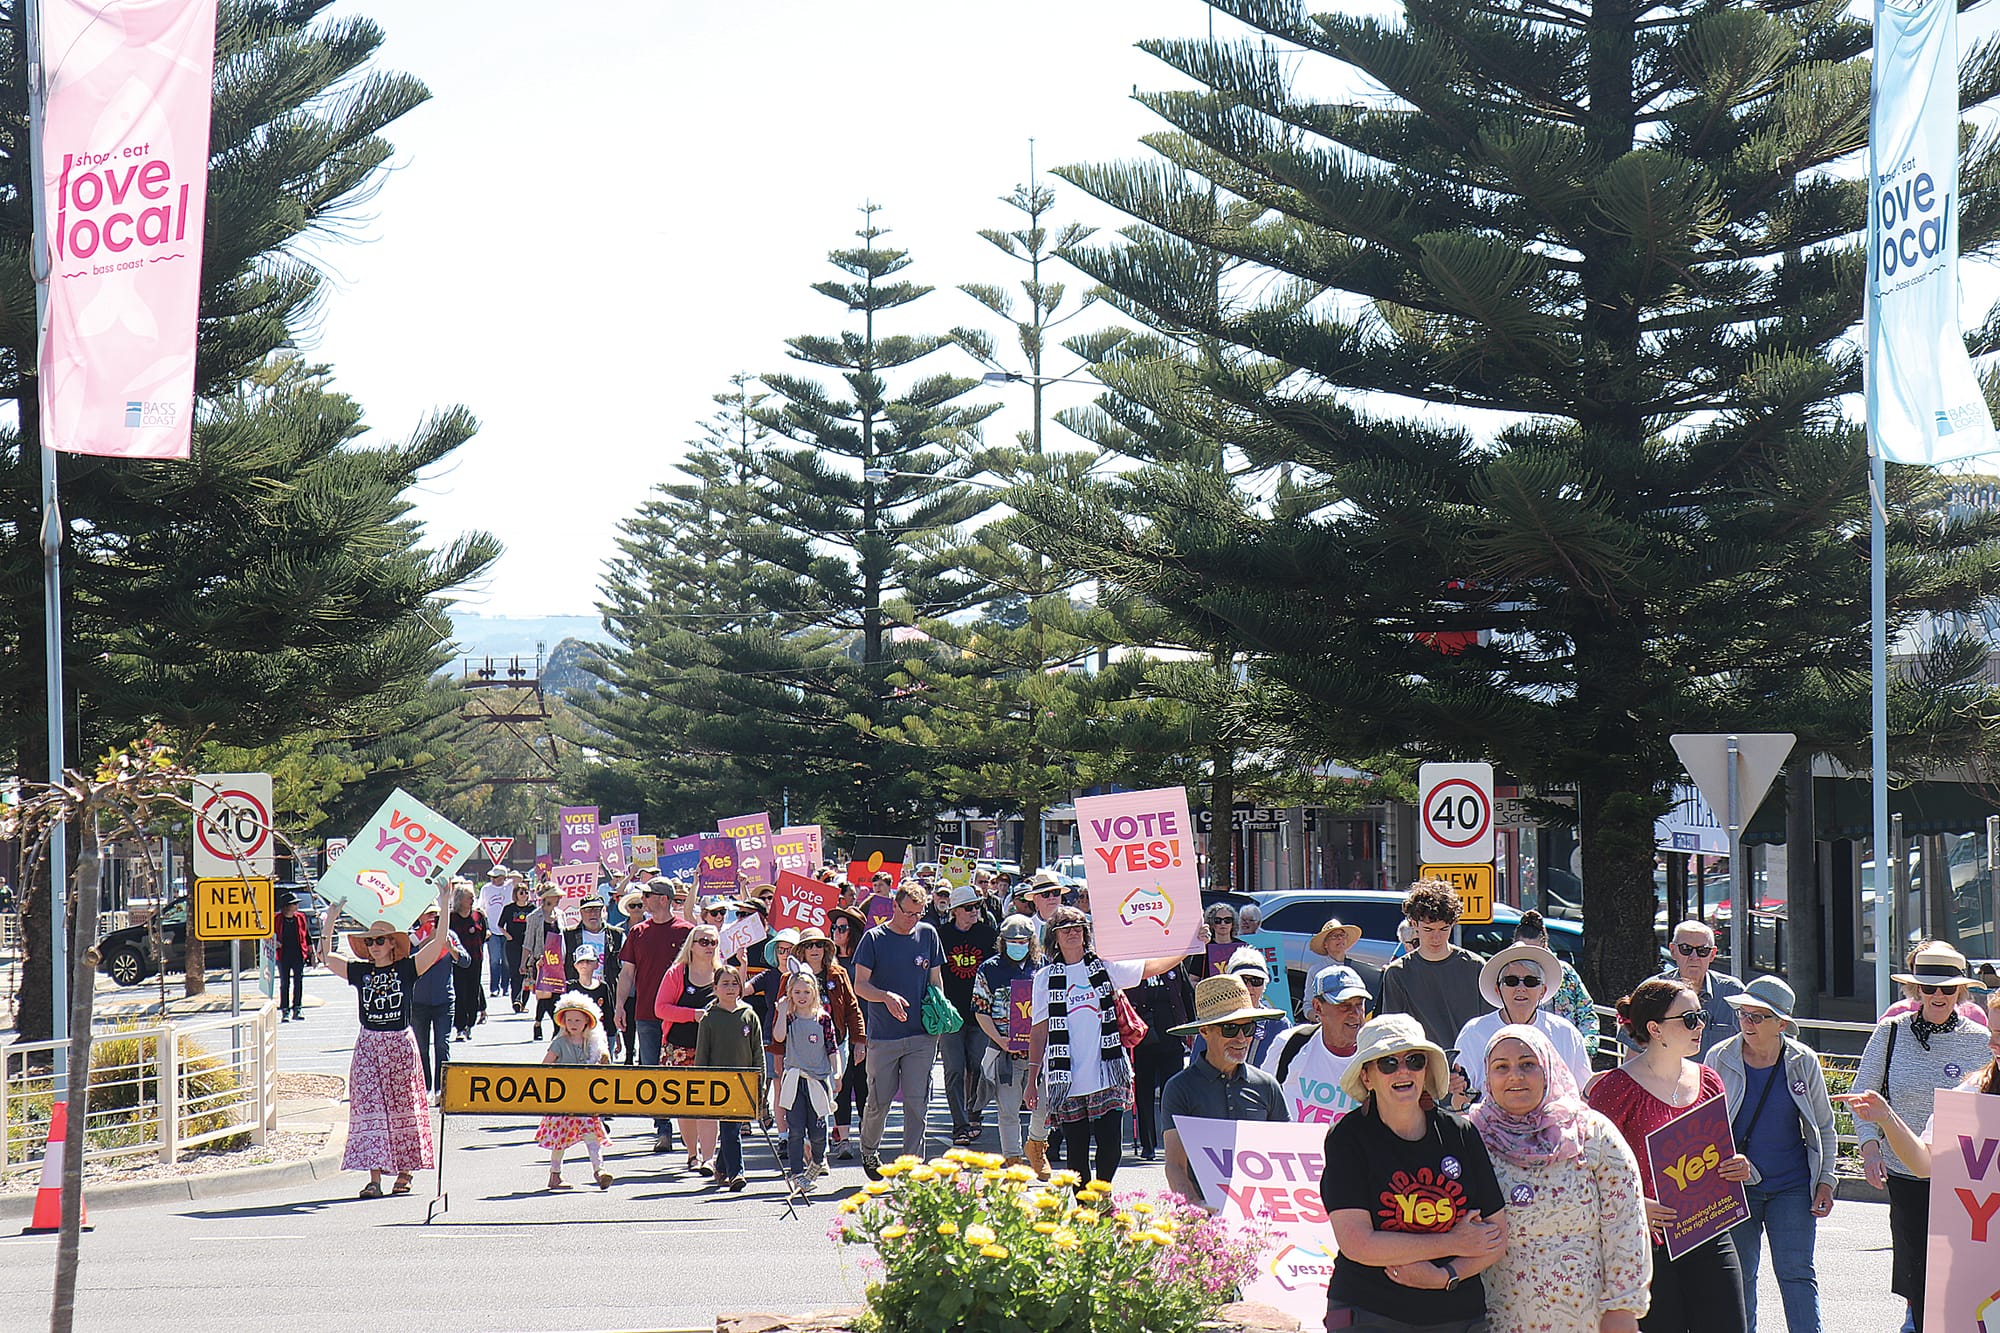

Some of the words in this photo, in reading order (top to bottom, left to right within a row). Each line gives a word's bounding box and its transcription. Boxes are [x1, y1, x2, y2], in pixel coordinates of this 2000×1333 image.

[76, 152, 110, 166] shop
[123, 143, 150, 158] eat
[1902, 156, 1916, 174] eat
[58, 154, 171, 211] love
[1876, 172, 1936, 230] love
[56, 184, 189, 262] local
[1874, 193, 1950, 282] local
[92, 265, 114, 275] bass
[116, 259, 144, 272] coast
[143, 402, 176, 415] BASS
[1948, 402, 1981, 421] BASS
[142, 416, 176, 425] COAST
[565, 814, 595, 824] VOTE
[1432, 795, 1480, 830] 40
[208, 808, 258, 843] 40
[565, 824, 595, 835] YES!
[600, 829, 618, 840] VOTE
[725, 823, 765, 838] VOTE
[1090, 811, 1178, 842] VOTE
[389, 809, 459, 865] VOTE
[601, 838, 619, 850] YES!
[375, 826, 444, 885] YES!
[636, 846, 651, 854] Yes
[672, 843, 694, 853] Vote
[1094, 840, 1182, 874] YES!
[704, 854, 732, 870] Yes
[368, 876, 395, 896] yes23
[556, 873, 593, 886] VOTE
[212, 887, 256, 905] NEW
[792, 883, 824, 905] Vote
[781, 895, 826, 926] YES
[1131, 901, 1163, 914] yes23
[206, 910, 263, 929] LIMIT
[728, 925, 752, 953] YES
[545, 950, 559, 965] Yes
[952, 954, 977, 967] Yes
[1069, 991, 1095, 1005] yes23
[470, 1076, 566, 1104] ROAD
[588, 1078, 731, 1106] CLOSED
[1202, 1147, 1324, 1182] VOTE
[1663, 1143, 1720, 1192] Yes
[1394, 1194, 1453, 1225] Yes
[1676, 1222, 1682, 1230] A
[1682, 1201, 1717, 1226] meaningful
[1718, 1195, 1733, 1206] step
[1681, 1225, 1693, 1235] the
[1693, 1216, 1709, 1228] right
[1709, 1200, 1740, 1220] direction.
[1288, 1264, 1334, 1277] yes23
